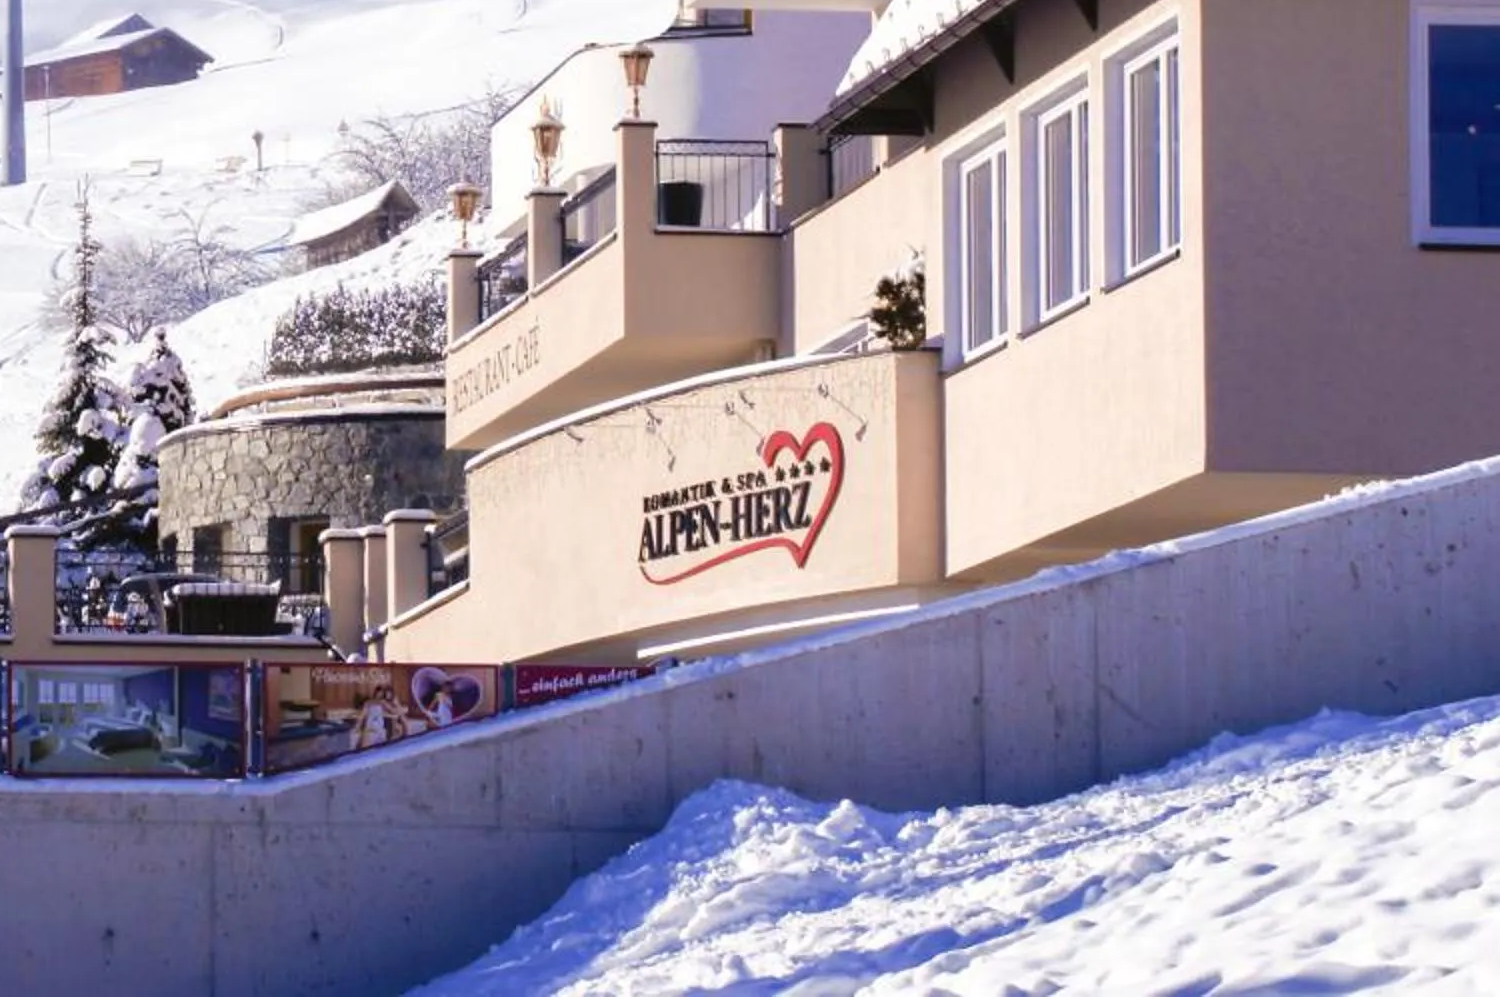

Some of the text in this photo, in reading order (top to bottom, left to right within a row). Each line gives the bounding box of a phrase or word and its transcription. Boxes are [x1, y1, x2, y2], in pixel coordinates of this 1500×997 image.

[638, 481, 812, 563] ALPEN-HERZ
[643, 471, 767, 513] ROMANTIK & SPA
